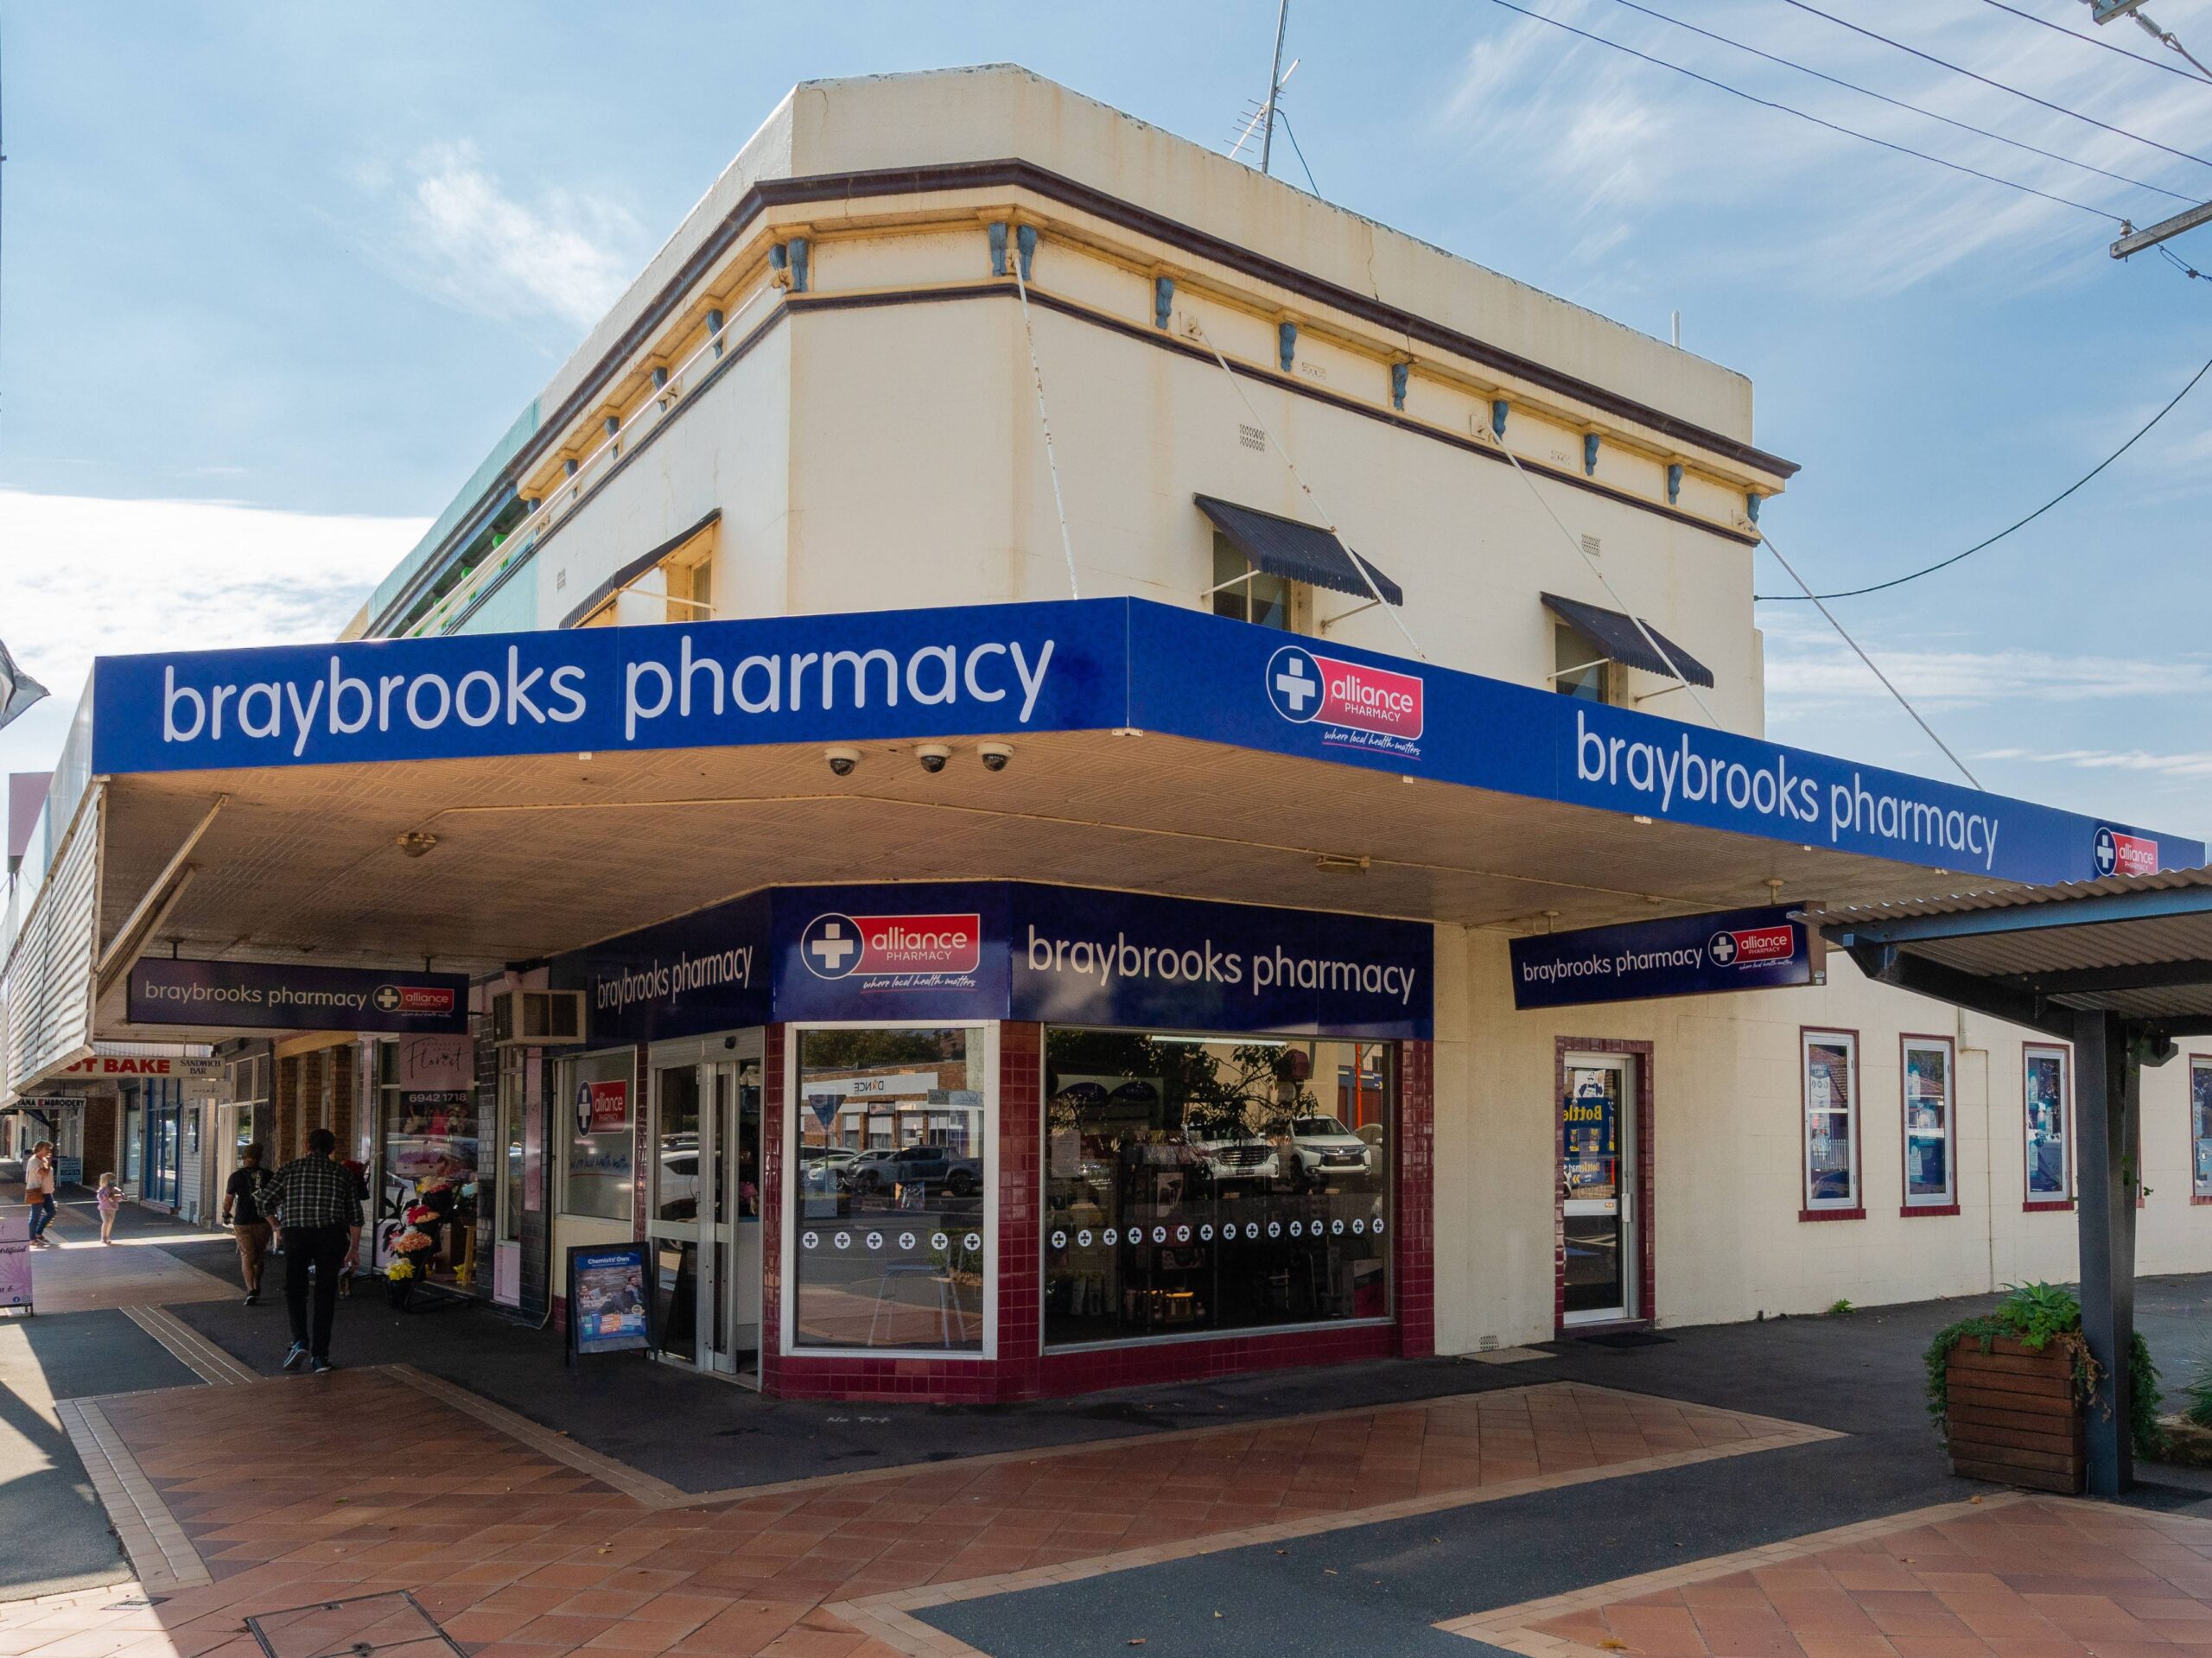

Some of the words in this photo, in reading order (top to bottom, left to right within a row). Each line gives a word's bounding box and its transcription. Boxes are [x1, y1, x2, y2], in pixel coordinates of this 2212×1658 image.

[162, 645, 588, 757] braybrooks
[625, 635, 1055, 741] pharmacy
[1332, 674, 1414, 713] alliance
[1344, 702, 1401, 723] PHARMACY
[1324, 728, 1348, 741] where
[1349, 731, 1369, 745] local
[1369, 734, 1394, 750] health
[1394, 742, 1421, 756] matters
[1577, 710, 1819, 822] braybrooks
[1831, 773, 1999, 871] pharmacy
[2119, 843, 2154, 864] alliance
[2125, 861, 2149, 871] PHARMACY
[872, 927, 968, 950] alliance
[1740, 936, 1787, 950] alliance
[887, 951, 951, 961] PHARMACY
[1027, 924, 1242, 987] braybrooks
[1253, 945, 1415, 1005] pharmacy
[1522, 945, 1611, 984] braybrooks
[1616, 943, 1702, 977] pharmacy
[598, 959, 670, 1015] braybrooks
[672, 945, 753, 1004] pharmacy
[863, 977, 889, 988] where
[892, 975, 913, 988] local
[912, 975, 944, 987] health
[944, 975, 977, 988] matters
[145, 981, 262, 1004] braybrooks
[268, 986, 367, 1011] pharmacy
[405, 992, 448, 1003] alliance
[104, 1058, 170, 1074] BAKE
[180, 1059, 221, 1068] SANDWICH
[403, 1037, 470, 1078] Florist
[37, 1098, 85, 1107] EMBROIDERY
[409, 1093, 441, 1102] 6942
[442, 1093, 467, 1102] 1718
[594, 1092, 623, 1113] alliance
